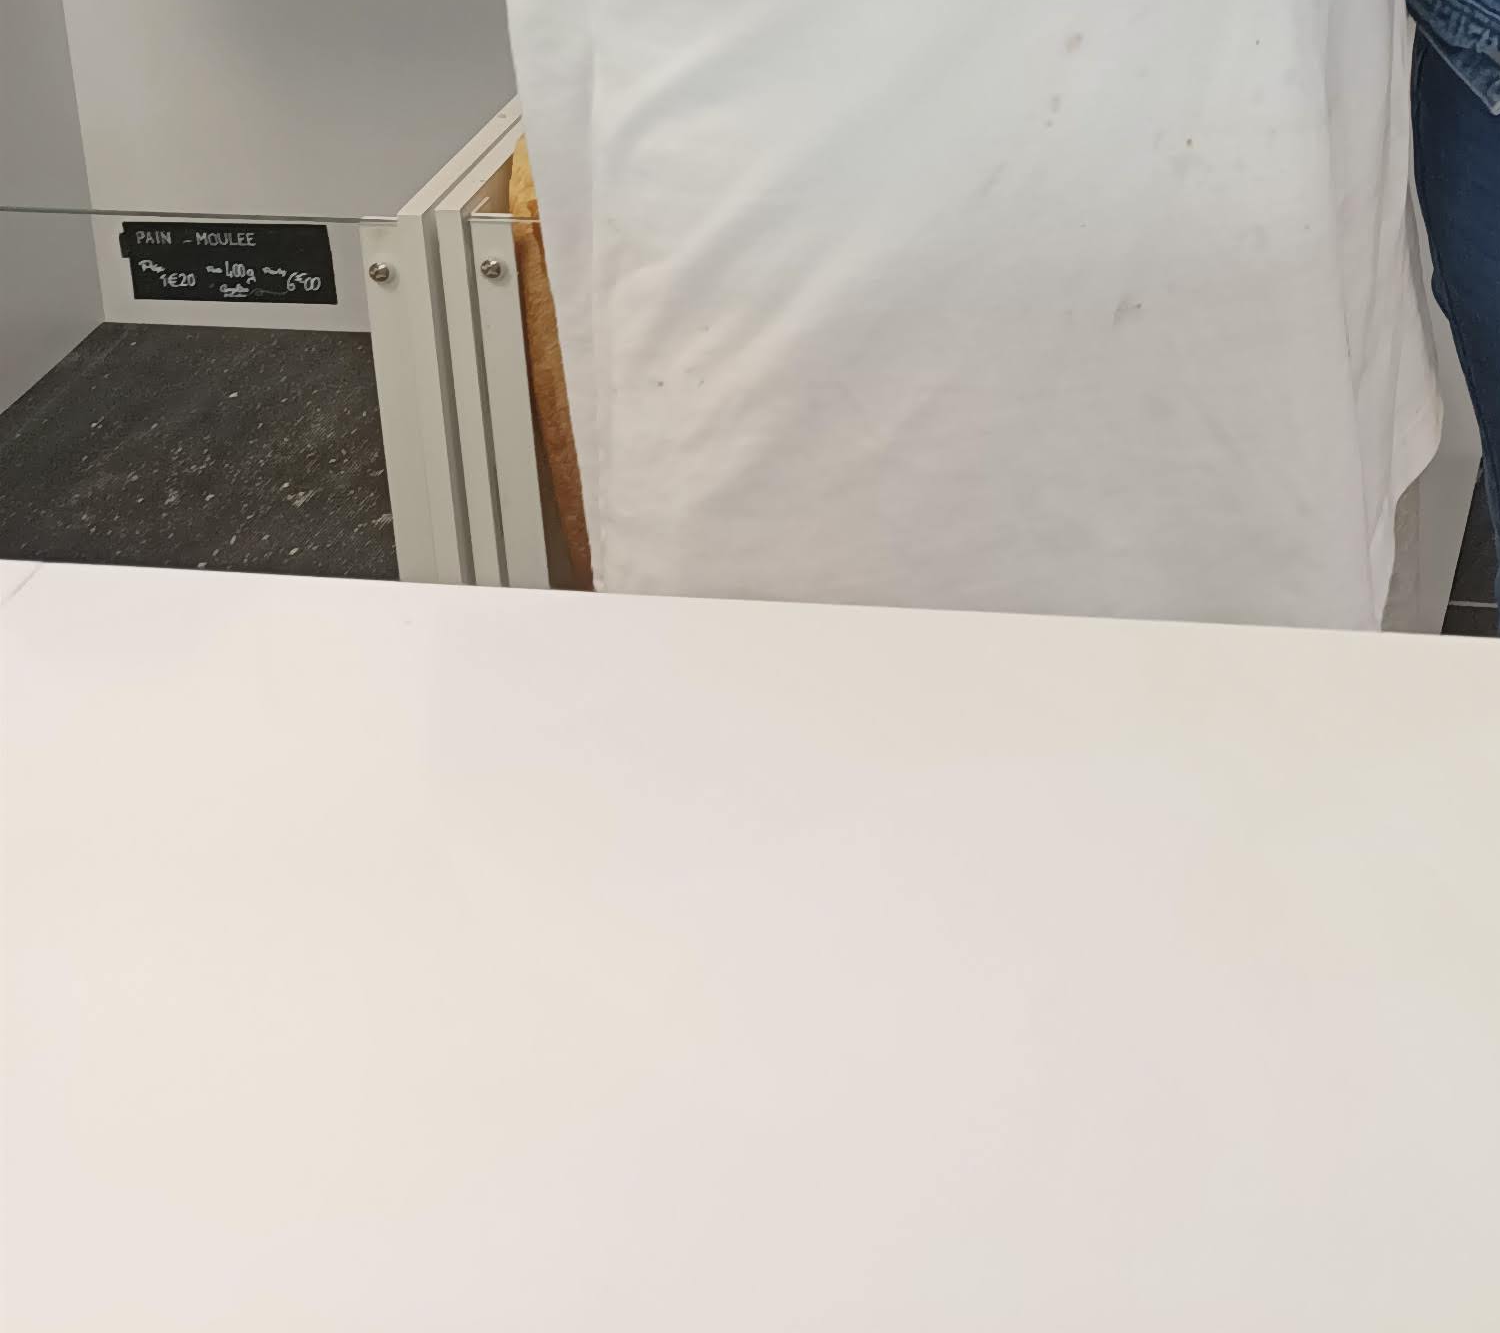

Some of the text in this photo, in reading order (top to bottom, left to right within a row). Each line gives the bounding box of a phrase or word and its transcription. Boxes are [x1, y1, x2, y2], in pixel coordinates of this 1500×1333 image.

[135, 230, 172, 245] PAIN
[196, 230, 257, 247] MOULEE
[159, 273, 196, 288] 1€20
[286, 271, 322, 292] 6€00
